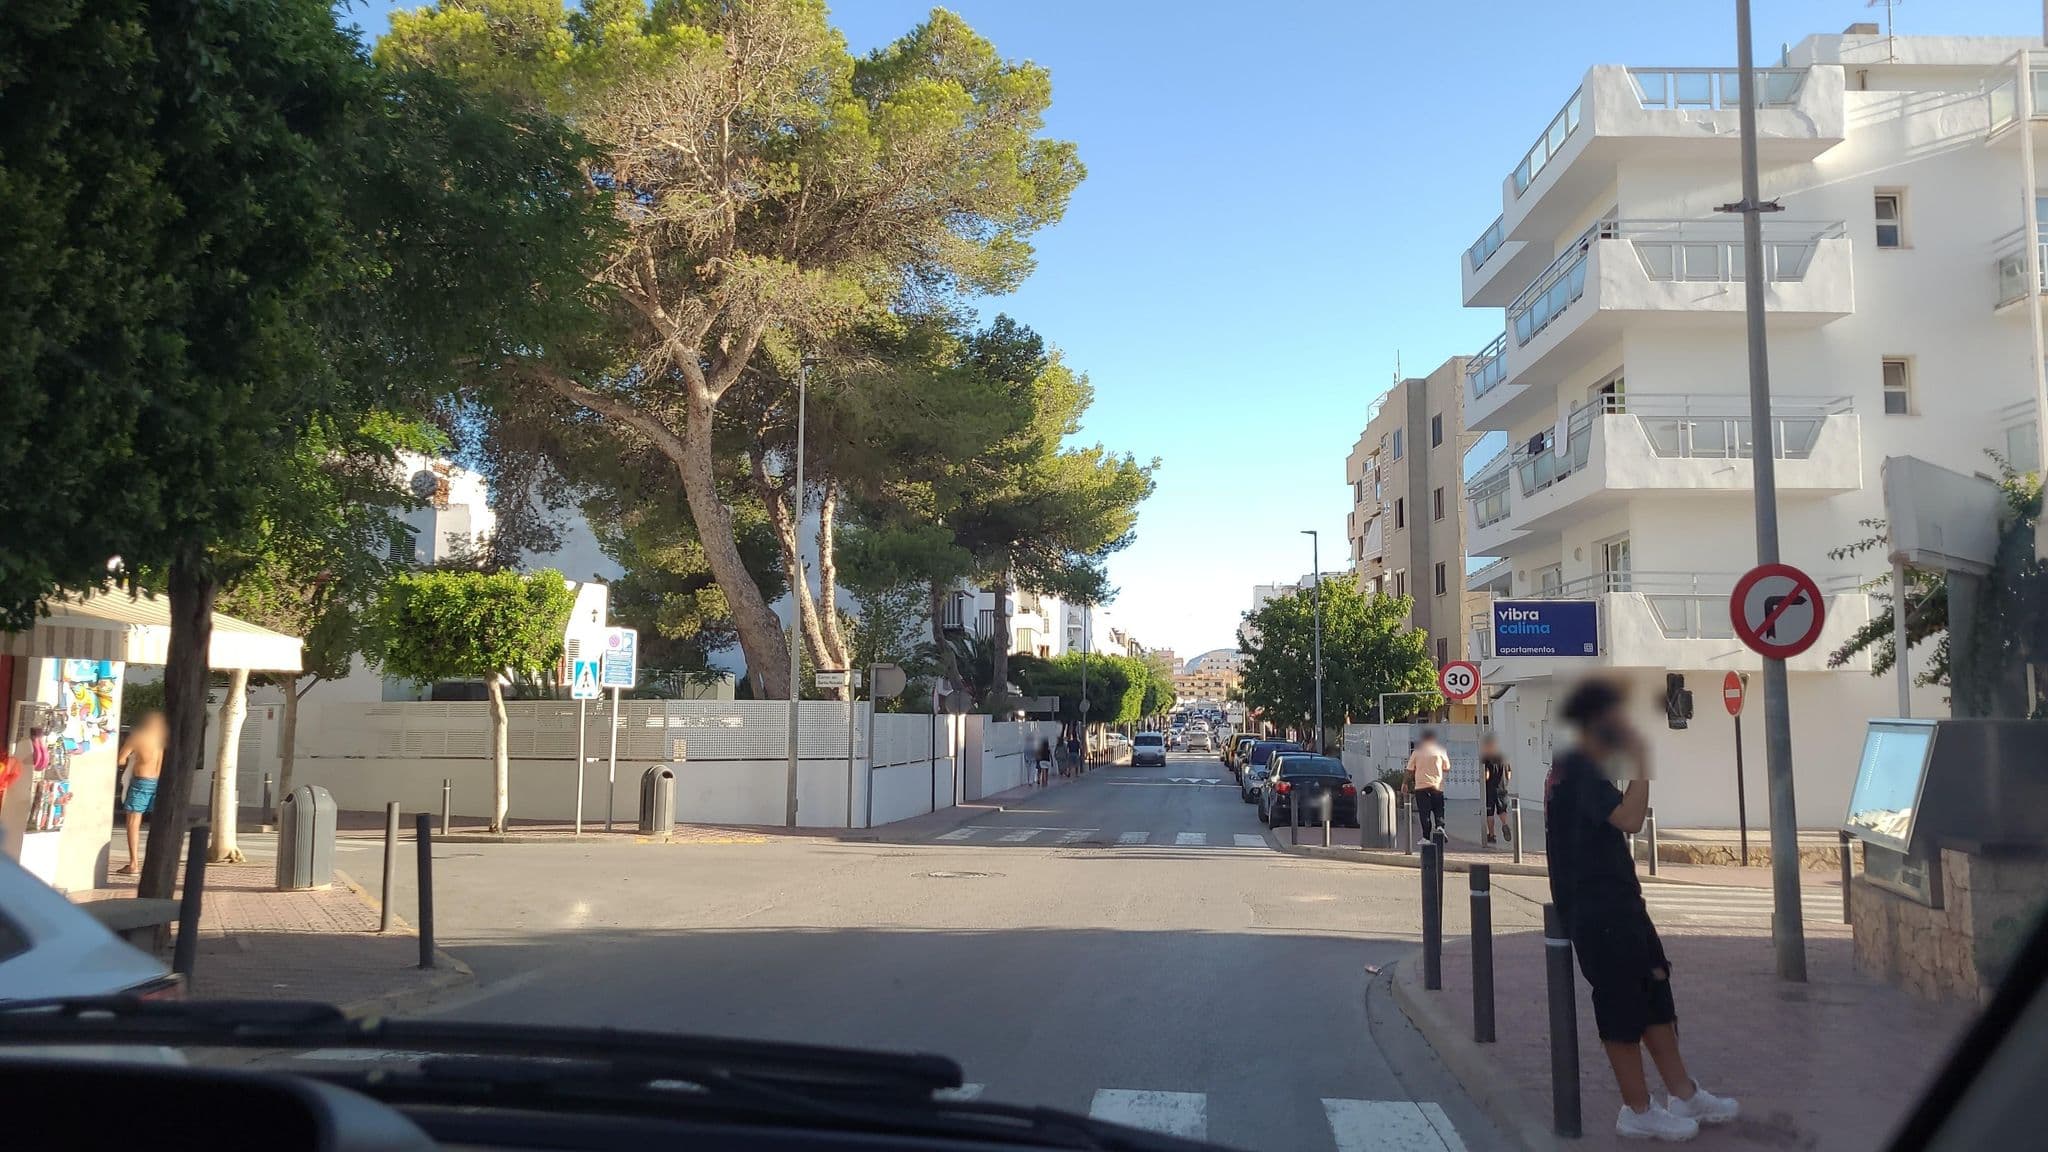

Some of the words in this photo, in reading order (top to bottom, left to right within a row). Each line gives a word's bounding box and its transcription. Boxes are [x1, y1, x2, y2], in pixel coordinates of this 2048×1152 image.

[1498, 607, 1540, 621] vibra
[1499, 621, 1551, 634] calima
[1499, 646, 1556, 654] apartamentos
[1447, 672, 1470, 687] 30
